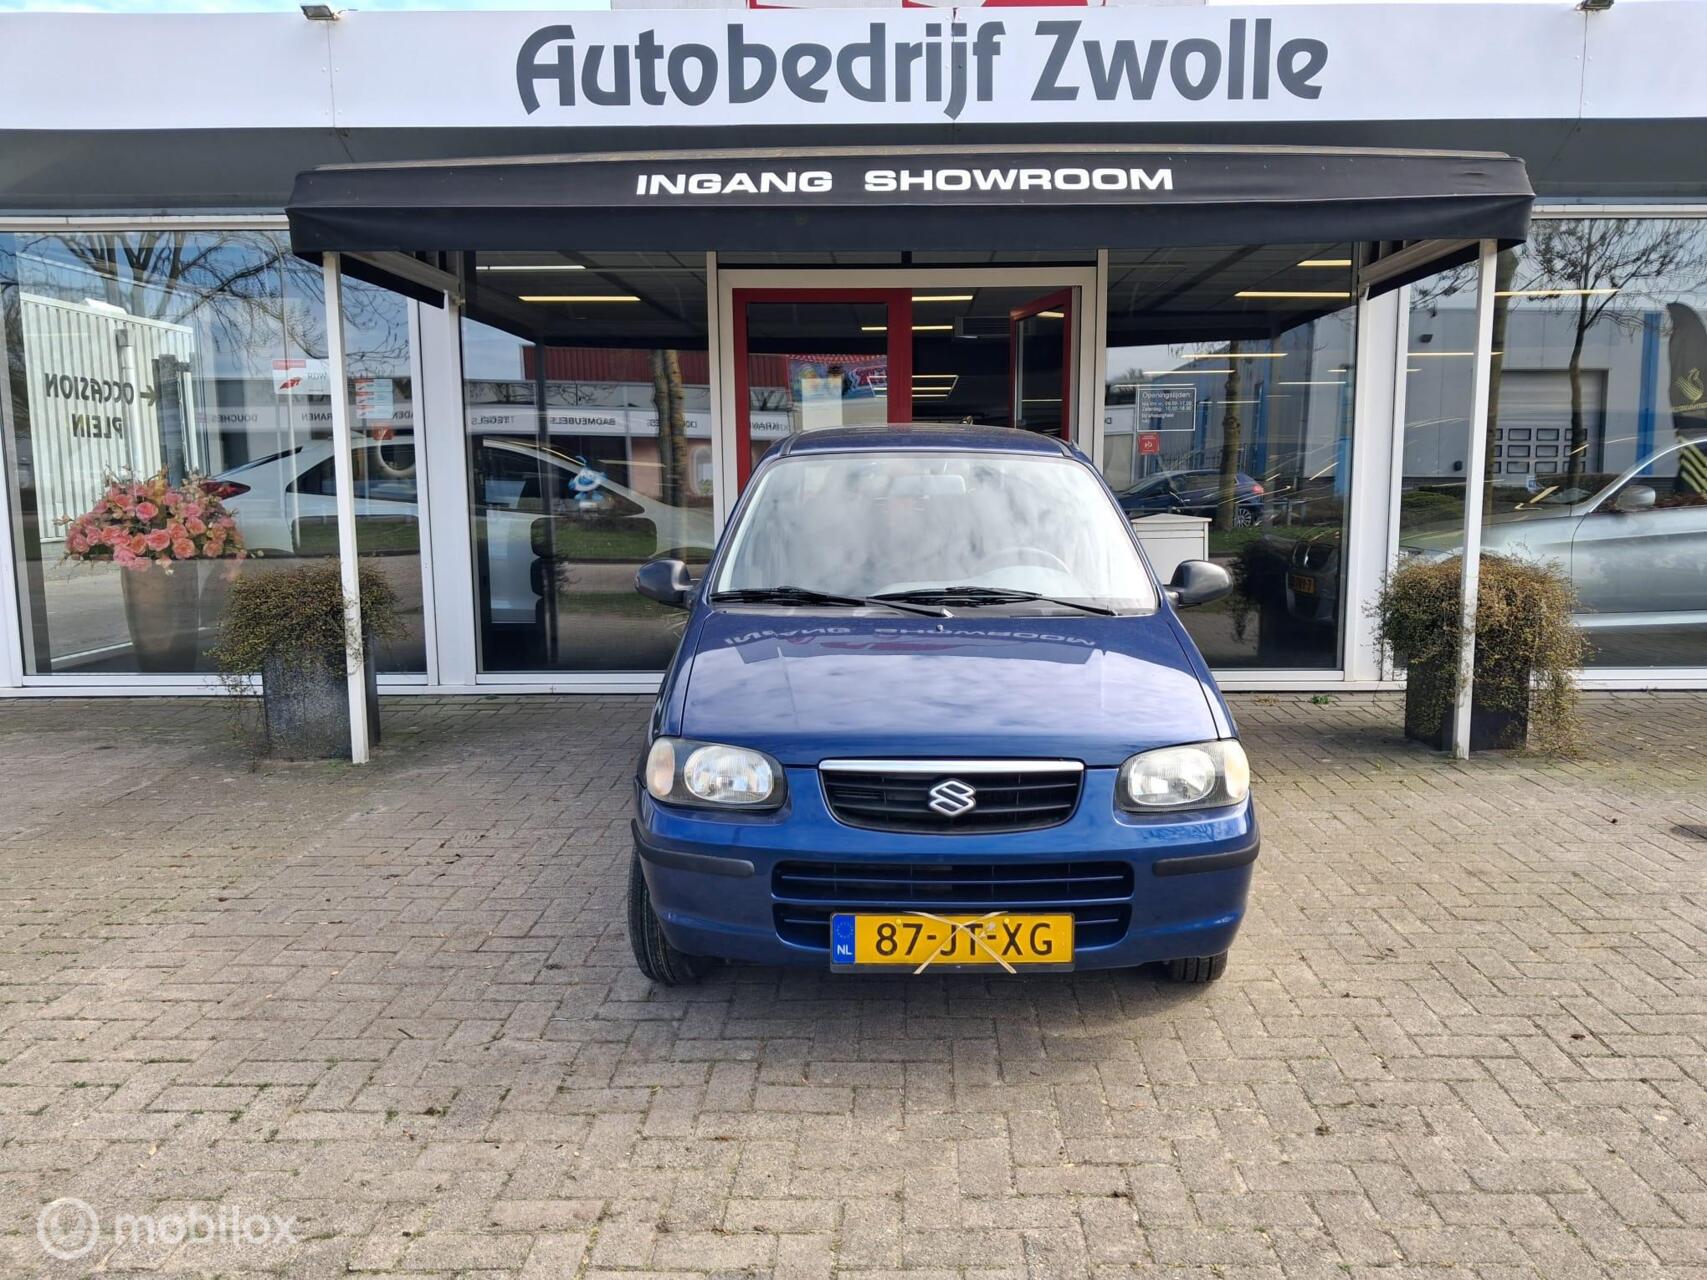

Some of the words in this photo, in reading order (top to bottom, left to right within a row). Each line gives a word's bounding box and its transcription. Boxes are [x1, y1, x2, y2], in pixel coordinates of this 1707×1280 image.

[516, 22, 1005, 120] Autobedrijf
[1031, 18, 1329, 101] Zwolle
[635, 170, 834, 196] INGANG
[863, 167, 1174, 193] SHOWROOM
[837, 945, 852, 956] NL
[875, 922, 1053, 956] 87-JT-XG
